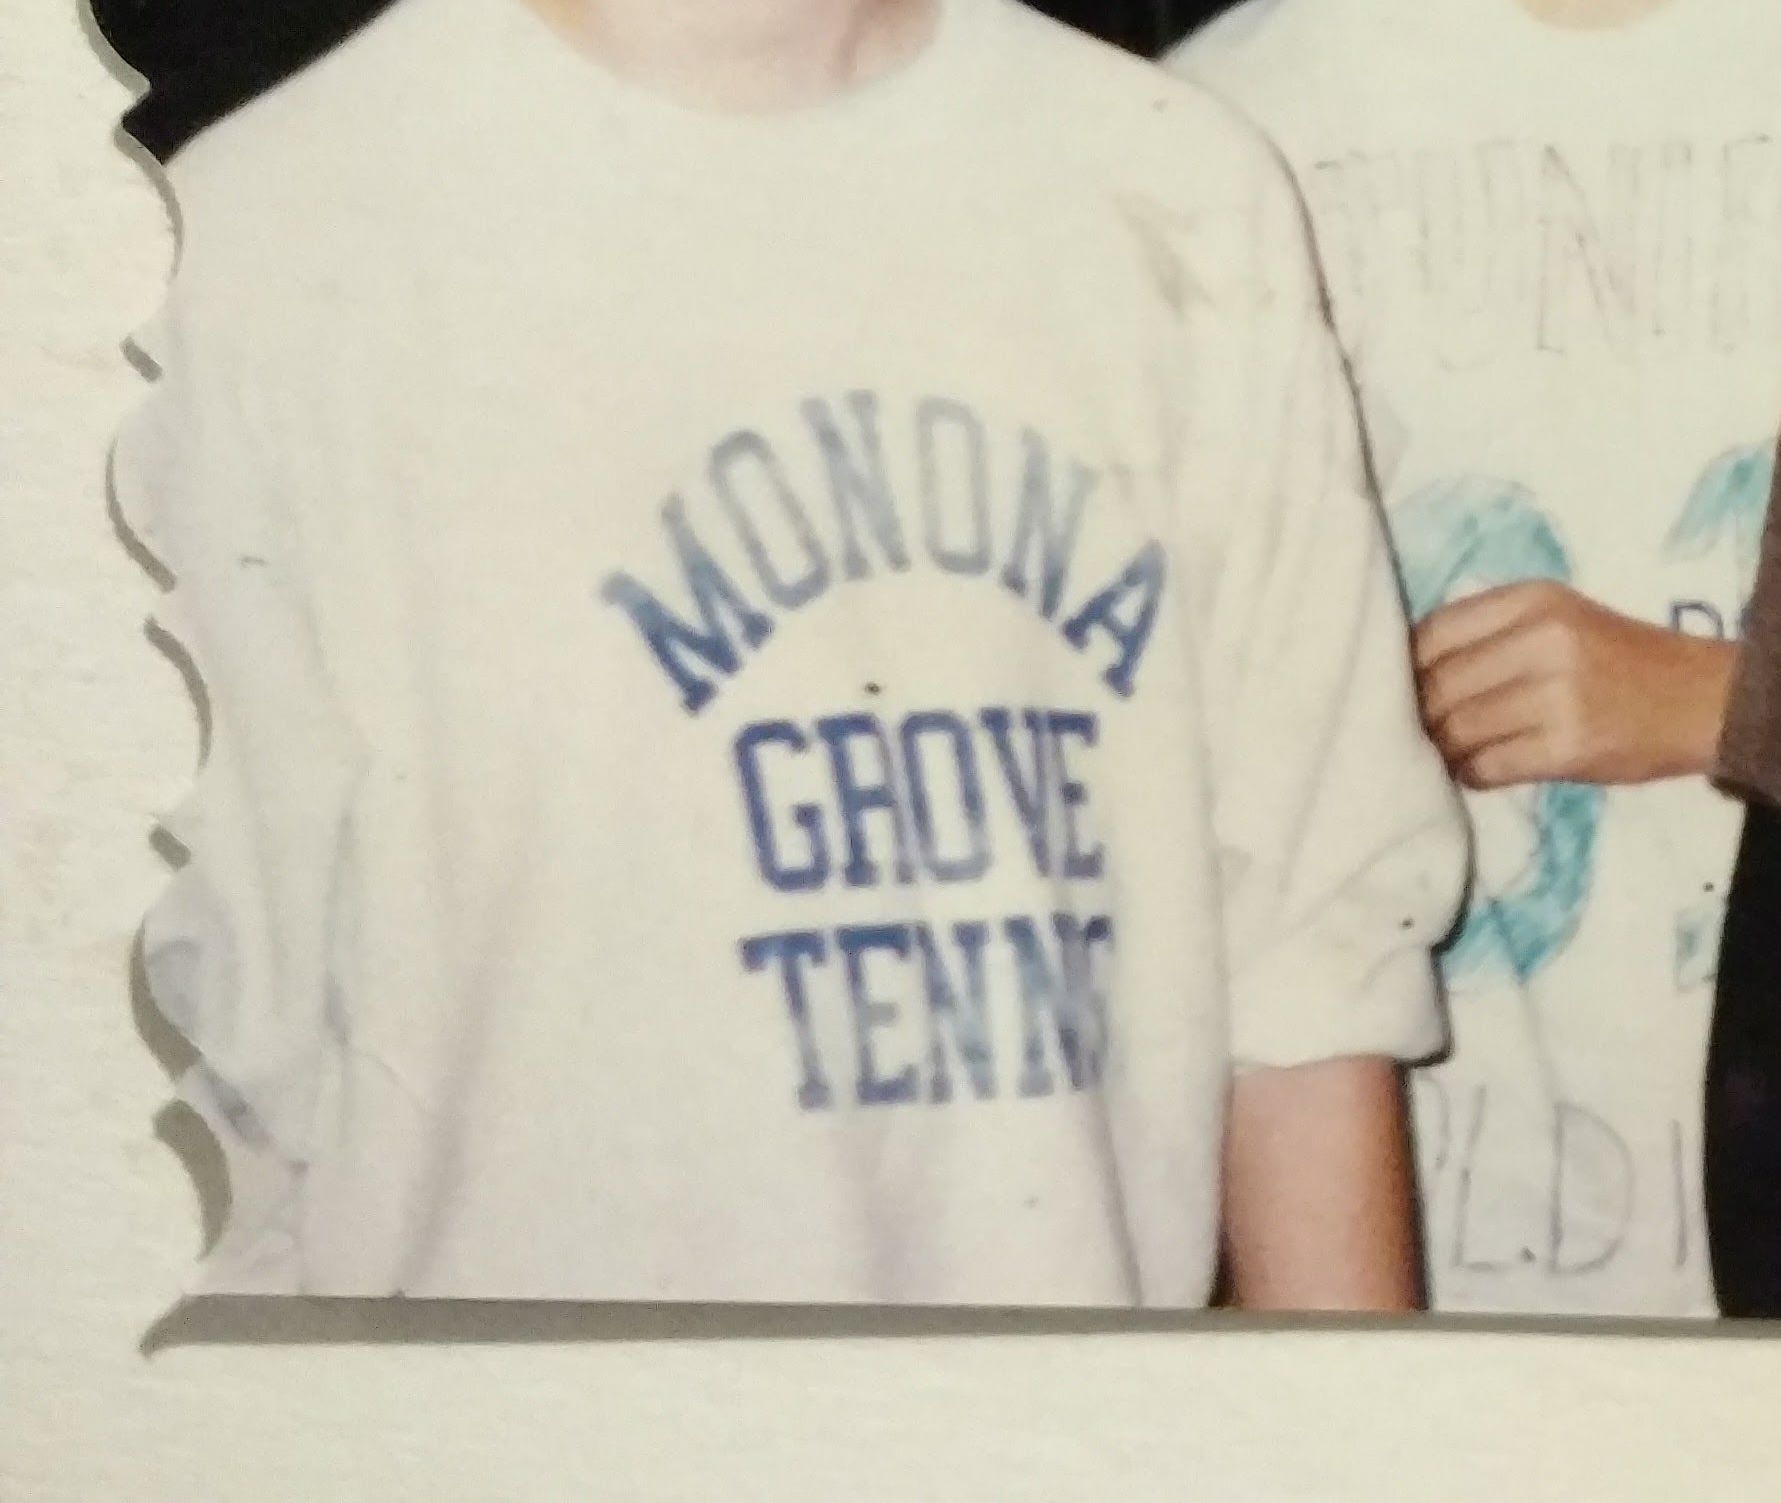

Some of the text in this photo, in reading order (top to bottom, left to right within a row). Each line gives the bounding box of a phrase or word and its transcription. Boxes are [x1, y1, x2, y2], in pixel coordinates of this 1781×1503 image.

[598, 388, 1169, 715] MONONA
[733, 706, 1107, 892] GROVE
[739, 911, 1115, 1111] TENN
